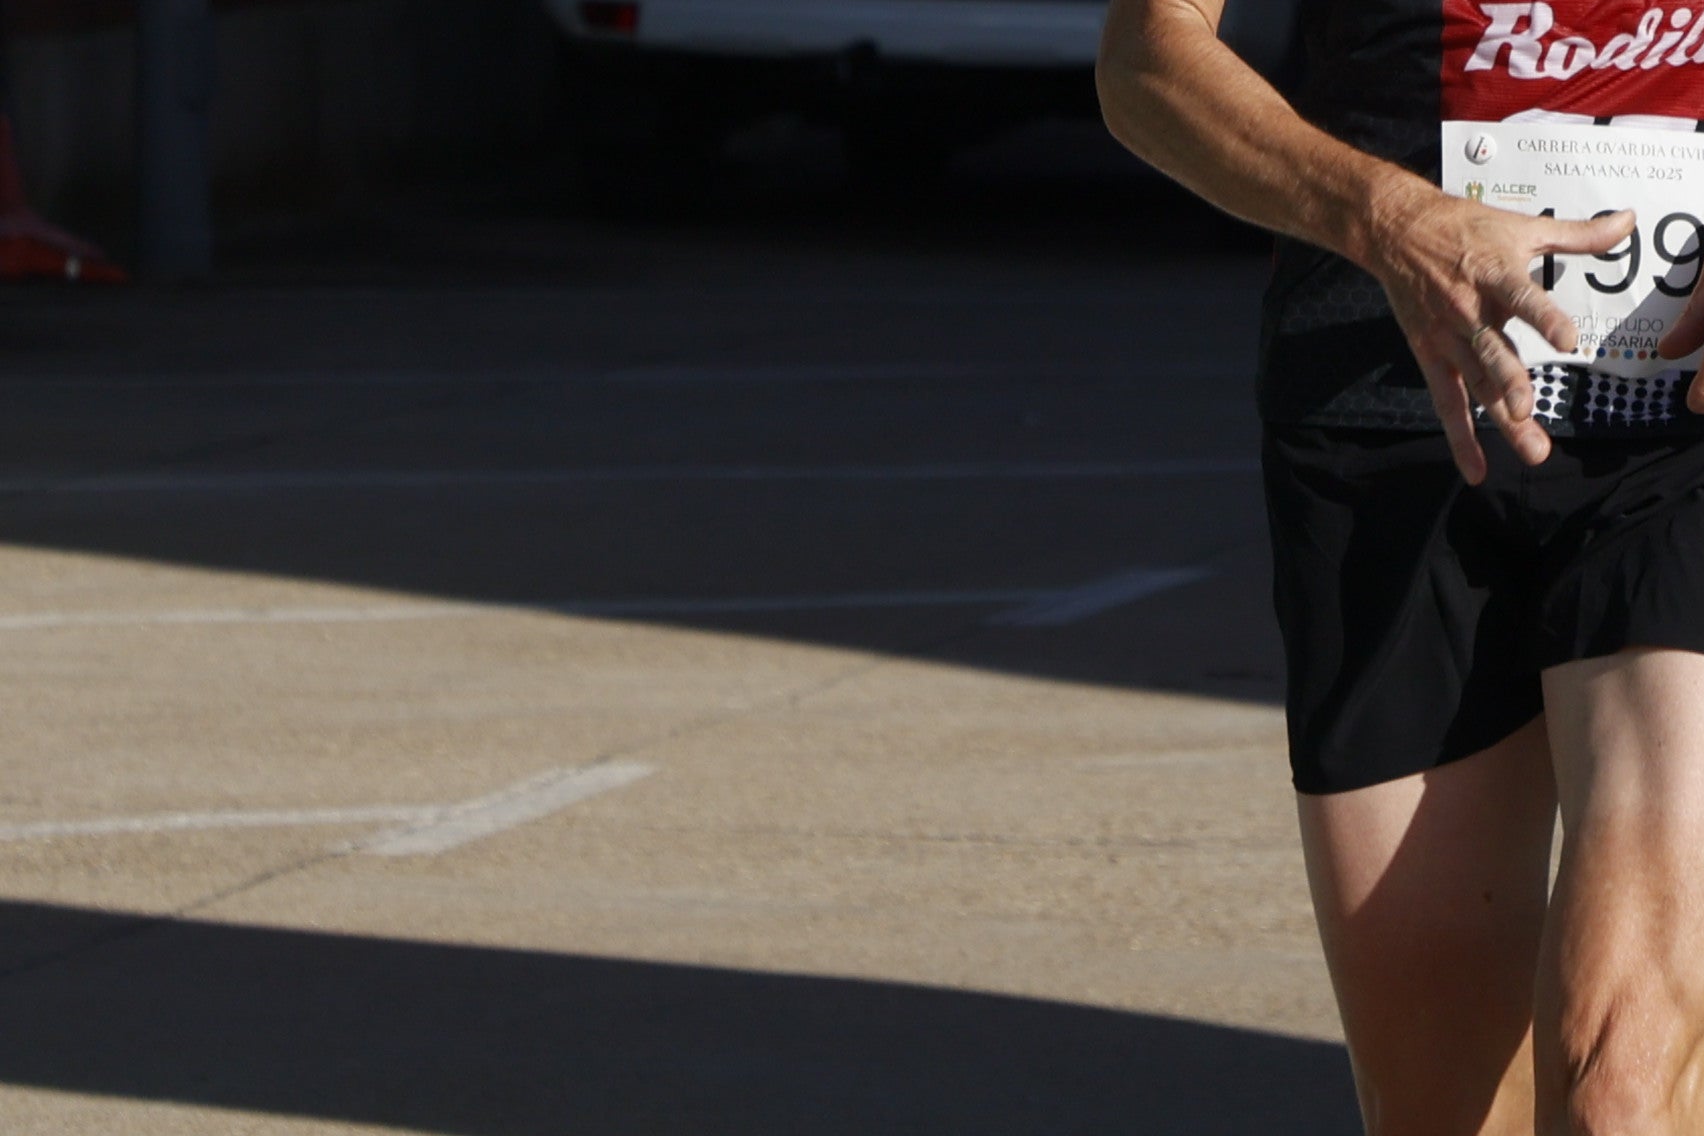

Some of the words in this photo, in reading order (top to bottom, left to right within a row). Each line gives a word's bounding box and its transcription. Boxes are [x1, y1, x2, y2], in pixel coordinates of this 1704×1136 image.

[1517, 138, 1592, 154] CARRERA
[1544, 162, 1641, 178] SALAMANCA
[1647, 167, 1684, 181] 2025
[1491, 183, 1538, 197] ALCER
[1570, 311, 1599, 330] ani
[1605, 316, 1665, 336] grupo
